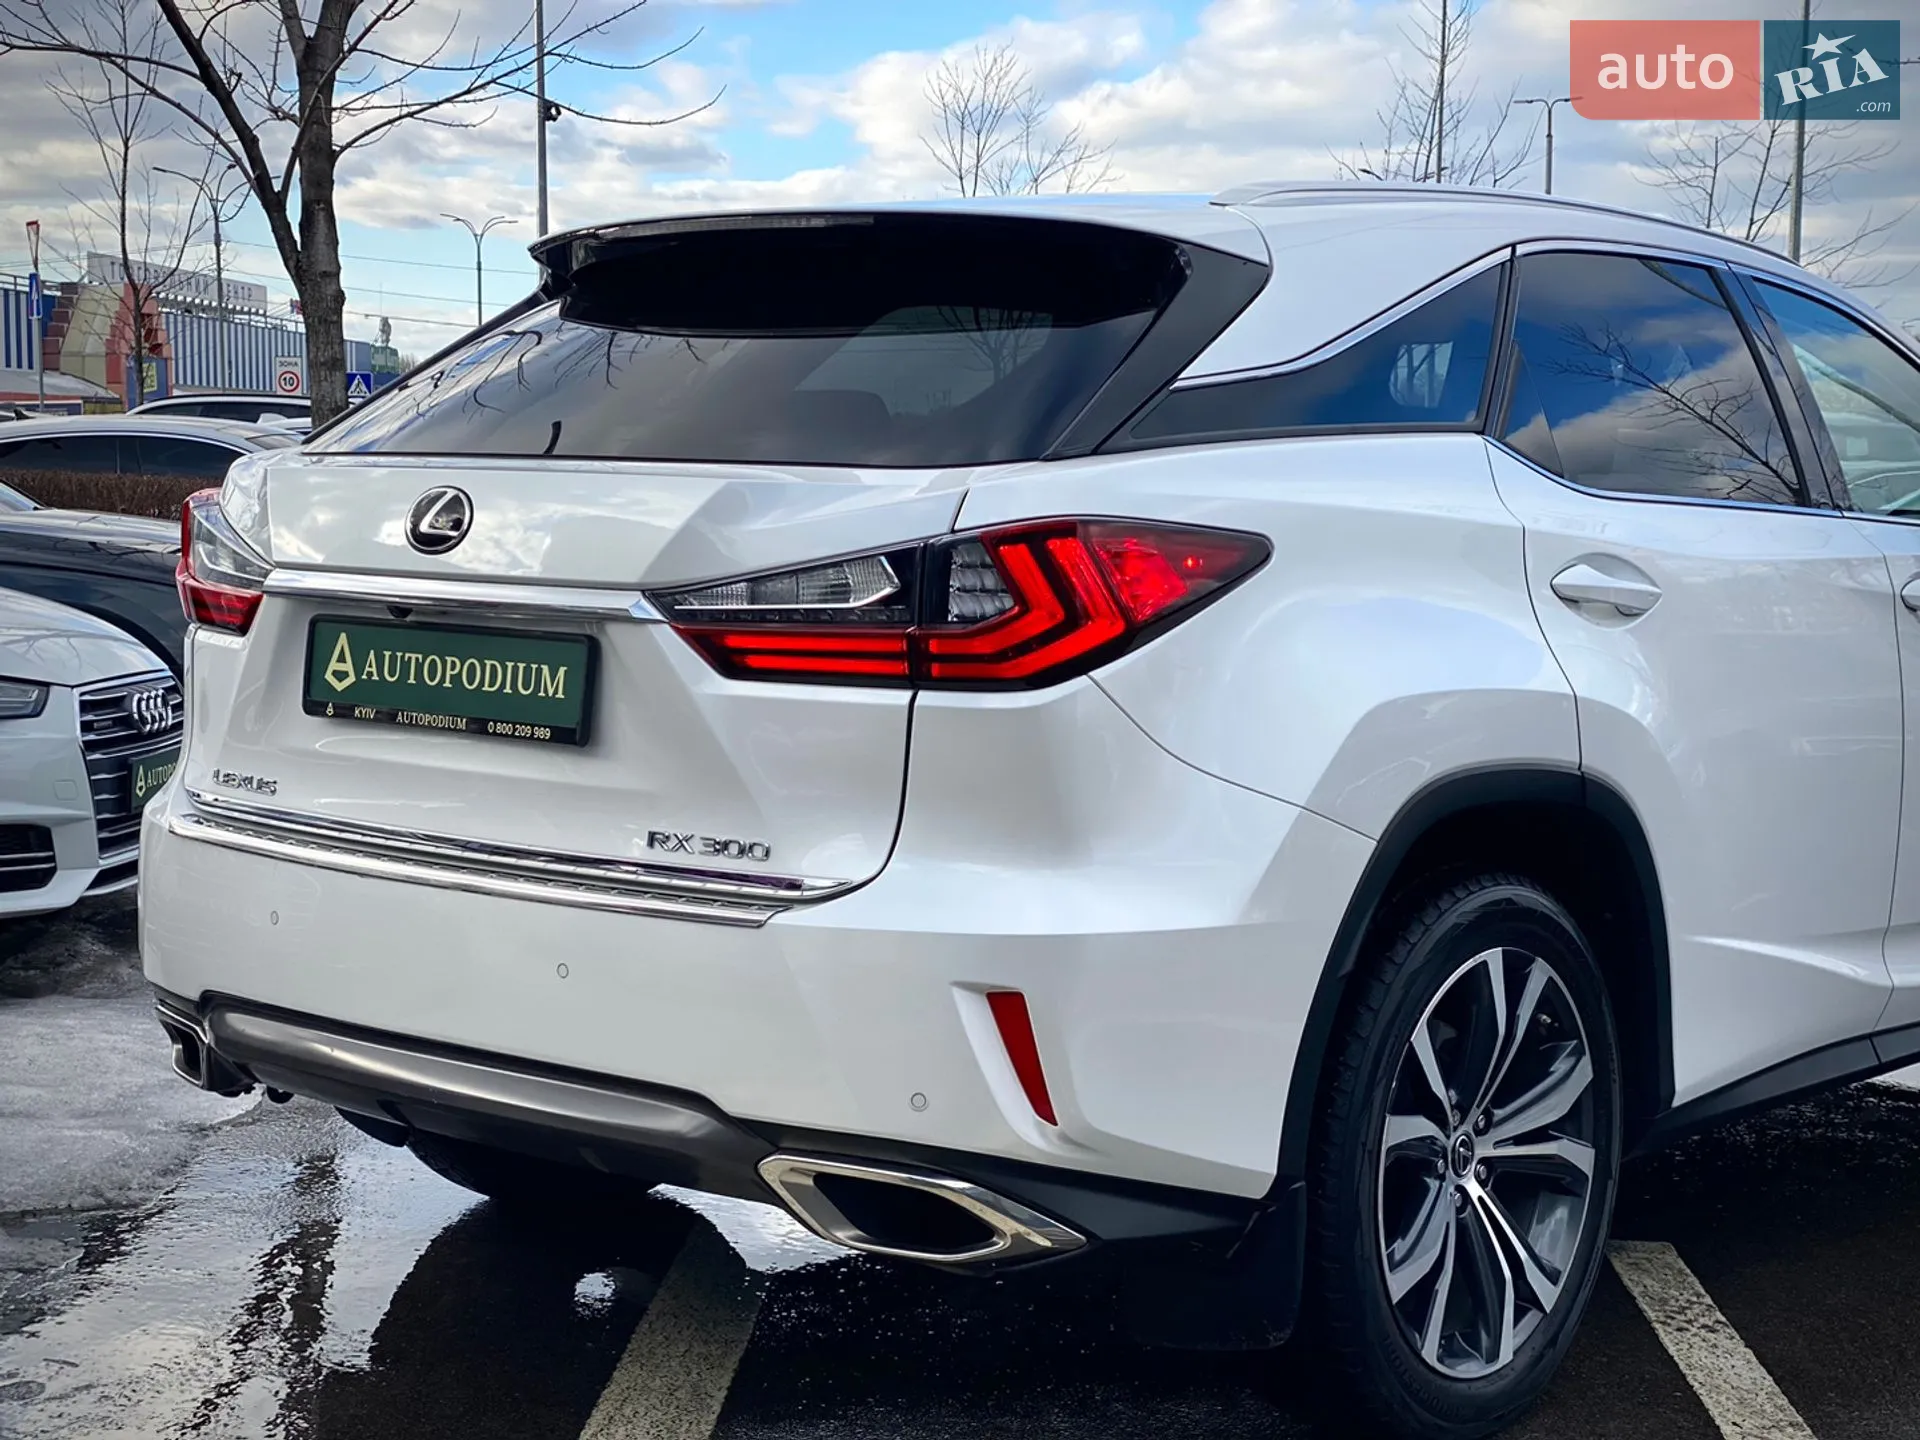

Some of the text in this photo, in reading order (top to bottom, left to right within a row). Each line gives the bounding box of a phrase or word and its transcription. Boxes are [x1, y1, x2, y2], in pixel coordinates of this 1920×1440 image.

[219, 282, 253, 300] ЕНТР
[278, 360, 298, 368] ЗОНА
[282, 376, 295, 387] 10
[361, 648, 568, 699] AUTOPODIUM
[354, 706, 551, 740] KYIV AUTOPODIUM 0 800 209 989
[213, 768, 278, 796] LEXUS
[646, 830, 771, 862] RX 300
